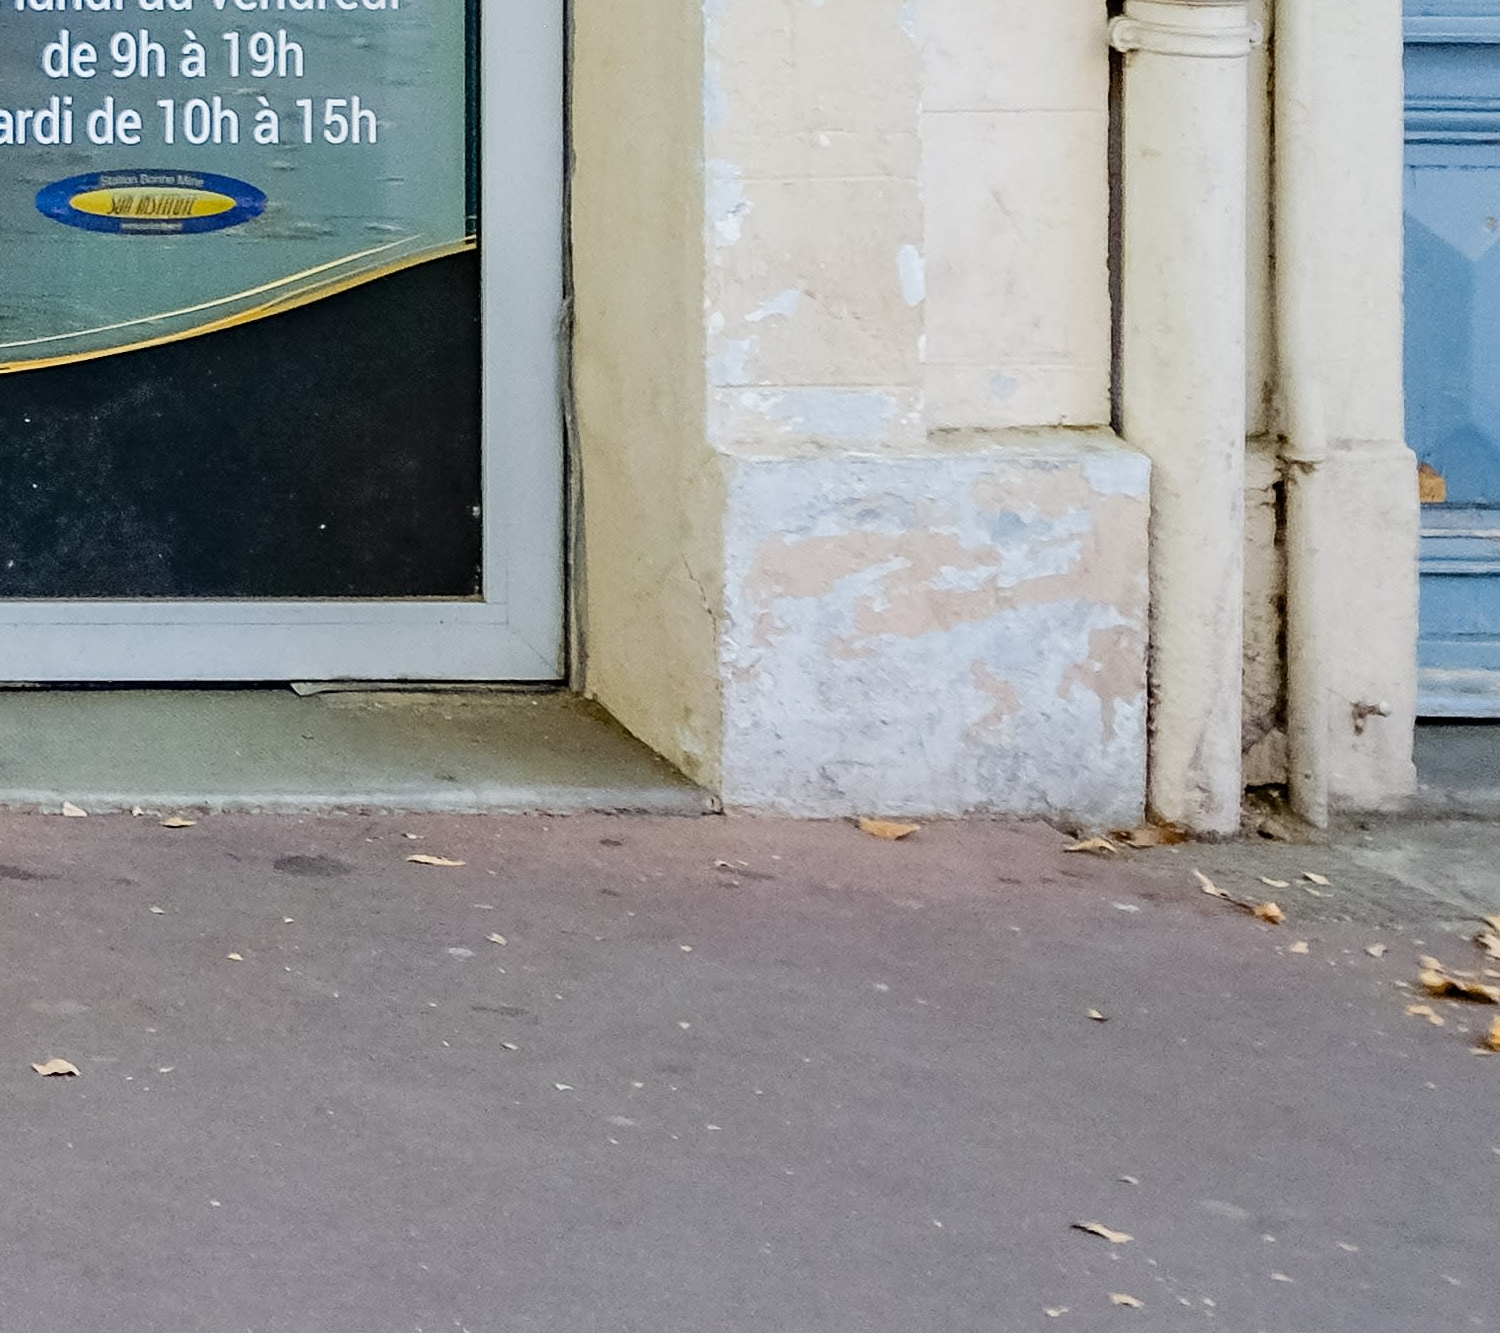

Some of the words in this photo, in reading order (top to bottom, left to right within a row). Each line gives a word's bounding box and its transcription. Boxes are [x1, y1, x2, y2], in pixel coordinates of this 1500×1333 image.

[42, 29, 99, 79] de
[109, 29, 166, 79] 9h
[178, 30, 207, 79] à
[223, 29, 304, 79] 19h
[86, 96, 144, 146] de
[157, 96, 239, 146] 10h
[254, 96, 280, 146] à
[298, 96, 378, 146] 15h
